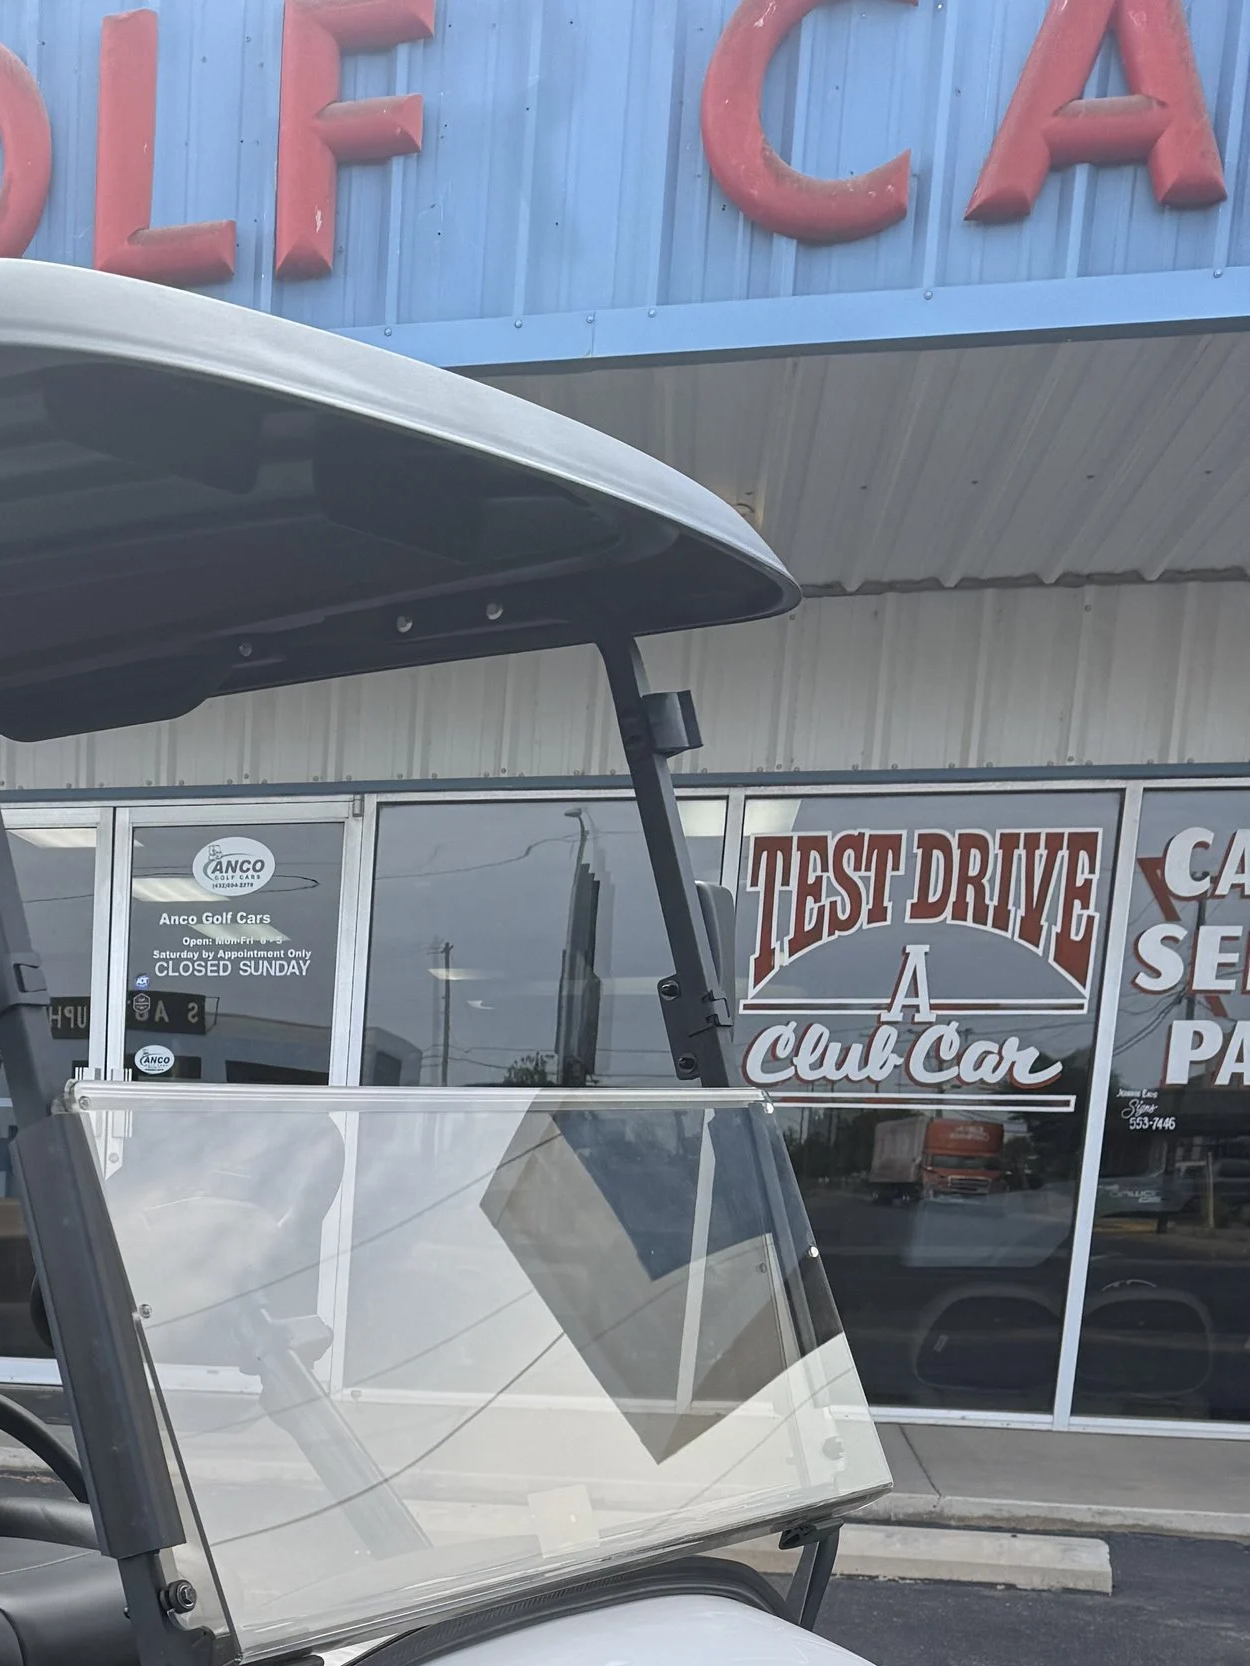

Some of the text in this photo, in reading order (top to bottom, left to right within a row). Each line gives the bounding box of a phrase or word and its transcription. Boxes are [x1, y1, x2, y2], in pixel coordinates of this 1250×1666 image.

[700, 0, 1228, 246] CA
[211, 859, 266, 874] ANCO
[159, 911, 272, 925] Anco Golf Cars
[746, 828, 1102, 999] TEST DRIVE
[182, 936, 213, 947] Open:
[153, 949, 312, 960] Saturday by Appointment Only
[1134, 923, 1250, 993] SE
[154, 959, 311, 977] CLOSED SUNDAY
[879, 944, 937, 1023] A
[143, 1056, 170, 1064] ANCO
[744, 1020, 1064, 1088] Club Car
[1121, 1099, 1158, 1119] Signs
